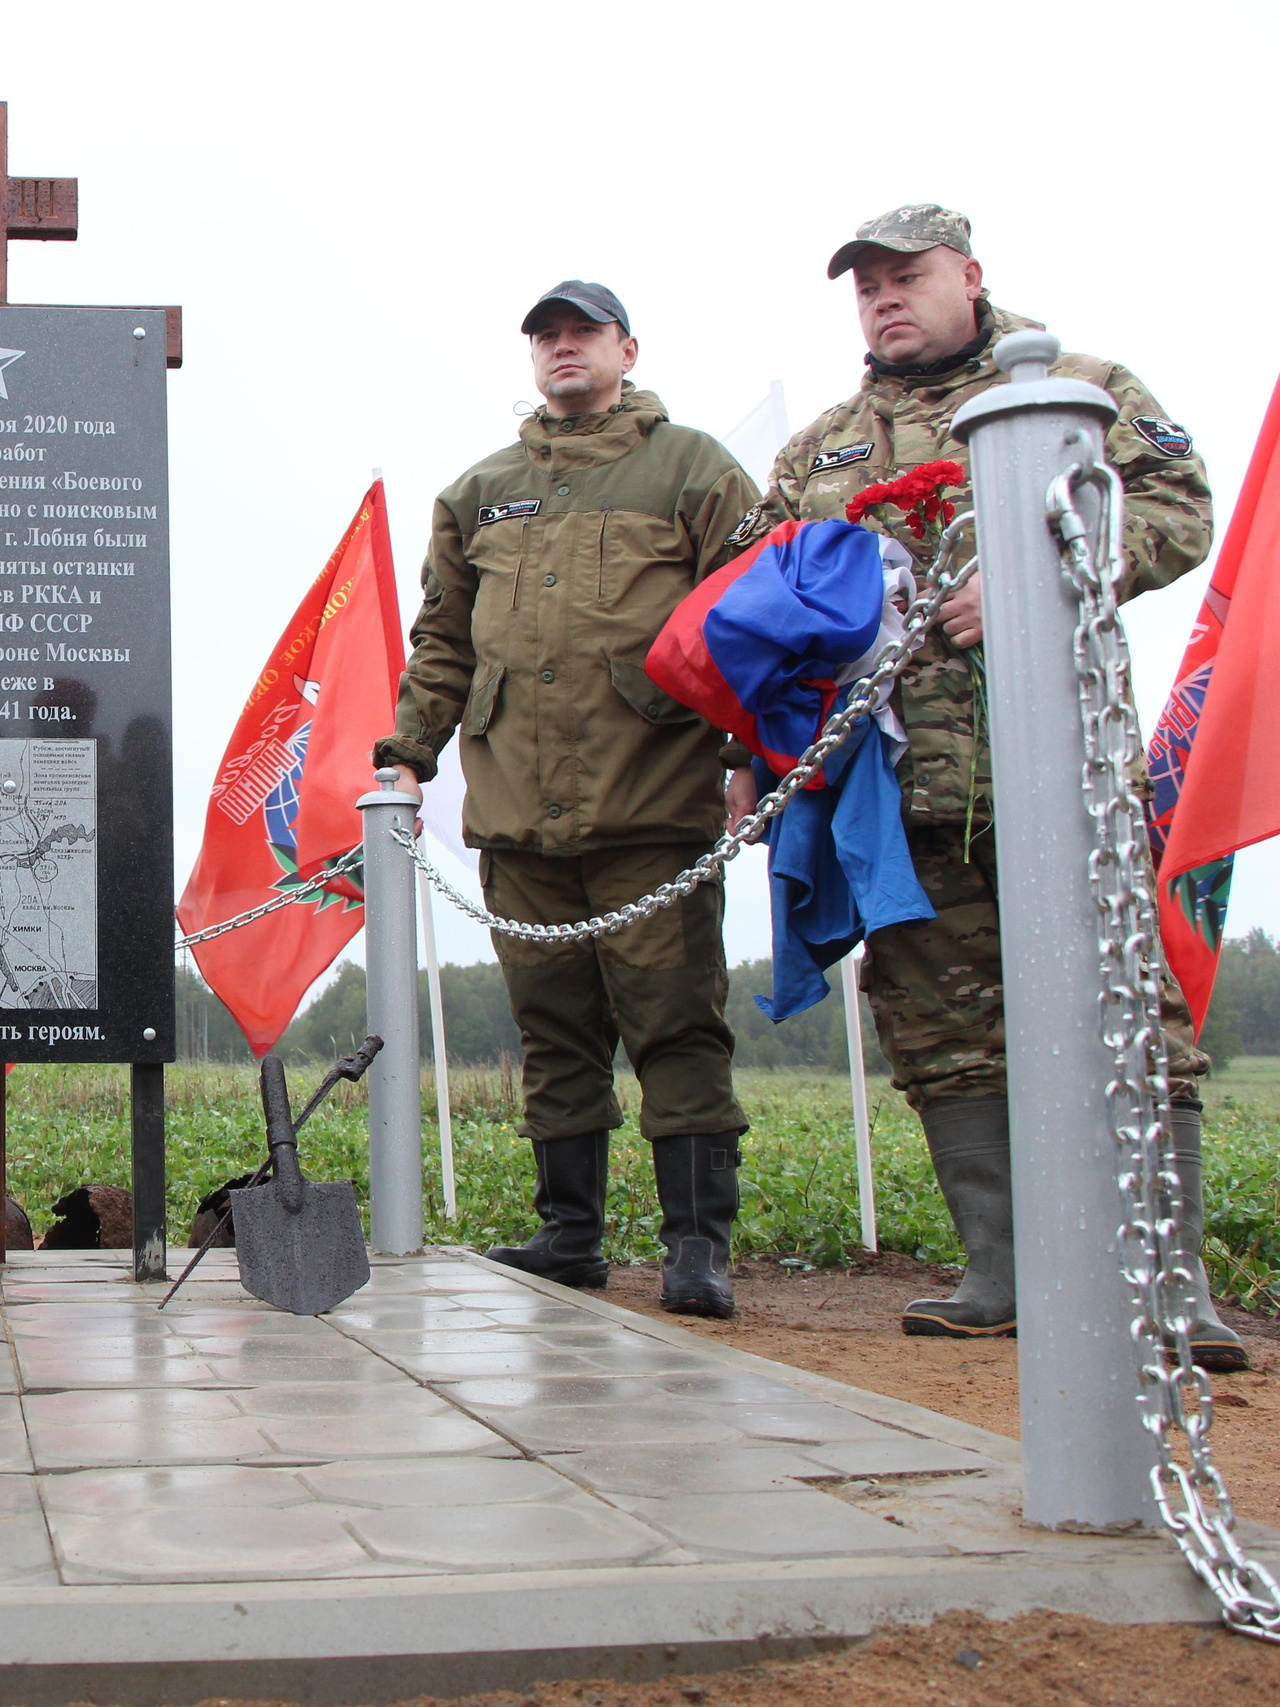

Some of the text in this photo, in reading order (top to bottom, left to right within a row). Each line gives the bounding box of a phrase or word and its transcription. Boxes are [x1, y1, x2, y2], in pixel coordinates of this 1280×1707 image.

[23, 414, 68, 434] 2020
[73, 420, 116, 438] года
[51, 471, 143, 491] «Боевого
[27, 504, 37, 518] с
[42, 504, 157, 520] поисковым
[4, 532, 18, 546] г.
[23, 527, 88, 547] Лобня
[93, 527, 147, 548] были
[52, 561, 135, 576] останки
[20, 584, 84, 604] РККА
[89, 590, 102, 605] и
[30, 613, 93, 633] СССР
[45, 642, 131, 663] Москвы
[42, 676, 55, 691] в
[28, 705, 77, 723] года.
[12, 925, 42, 933] ХИМКИ
[14, 965, 47, 973] МОСКВА
[28, 1025, 106, 1046] героям.
